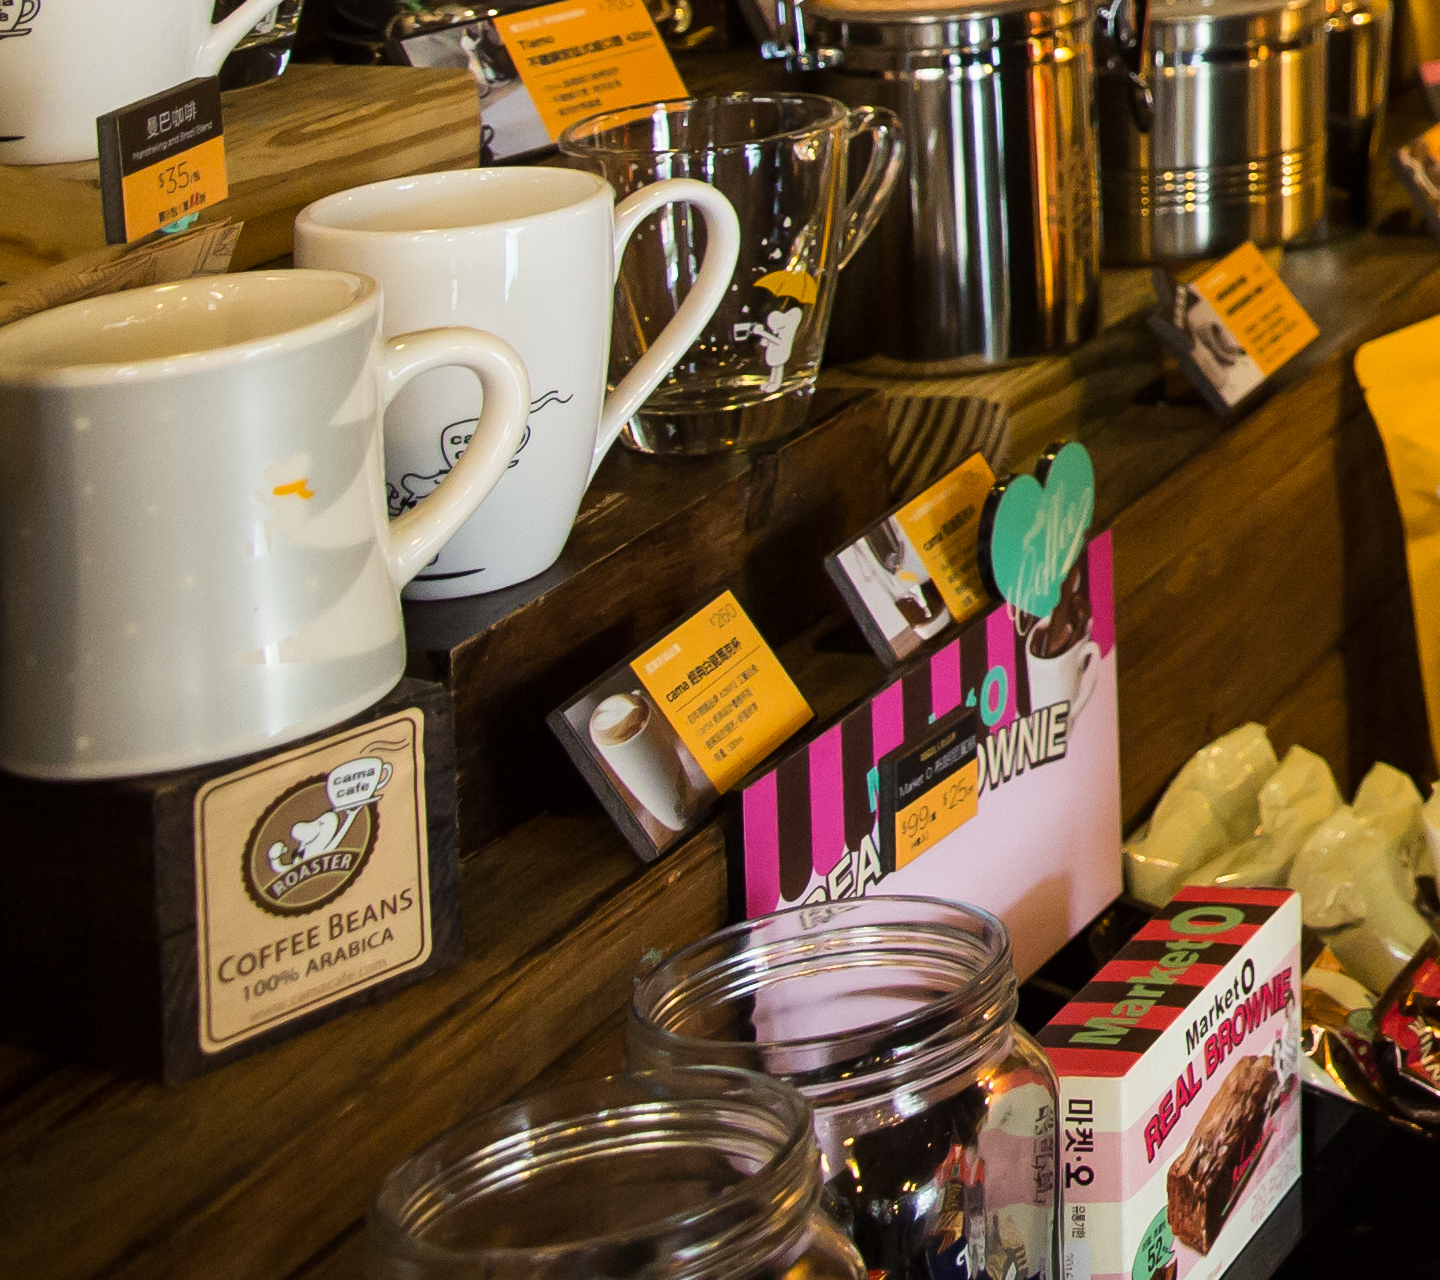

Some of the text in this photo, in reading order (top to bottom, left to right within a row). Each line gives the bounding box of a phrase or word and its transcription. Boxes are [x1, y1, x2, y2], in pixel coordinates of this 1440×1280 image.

[146, 100, 197, 139] 曼巴咖啡
[665, 680, 691, 704] cama
[332, 765, 376, 787] cama
[336, 780, 371, 799] cafe
[272, 852, 354, 900] ROASTER
[216, 886, 415, 985] COFFEE BEANS
[242, 926, 395, 1003] 100% ARABICA
[1068, 905, 1246, 1046] Market O
[1185, 957, 1256, 1056] Market O
[1143, 966, 1293, 1164] REAL BROWNIE
[1064, 1097, 1095, 1190] 마켓·오
